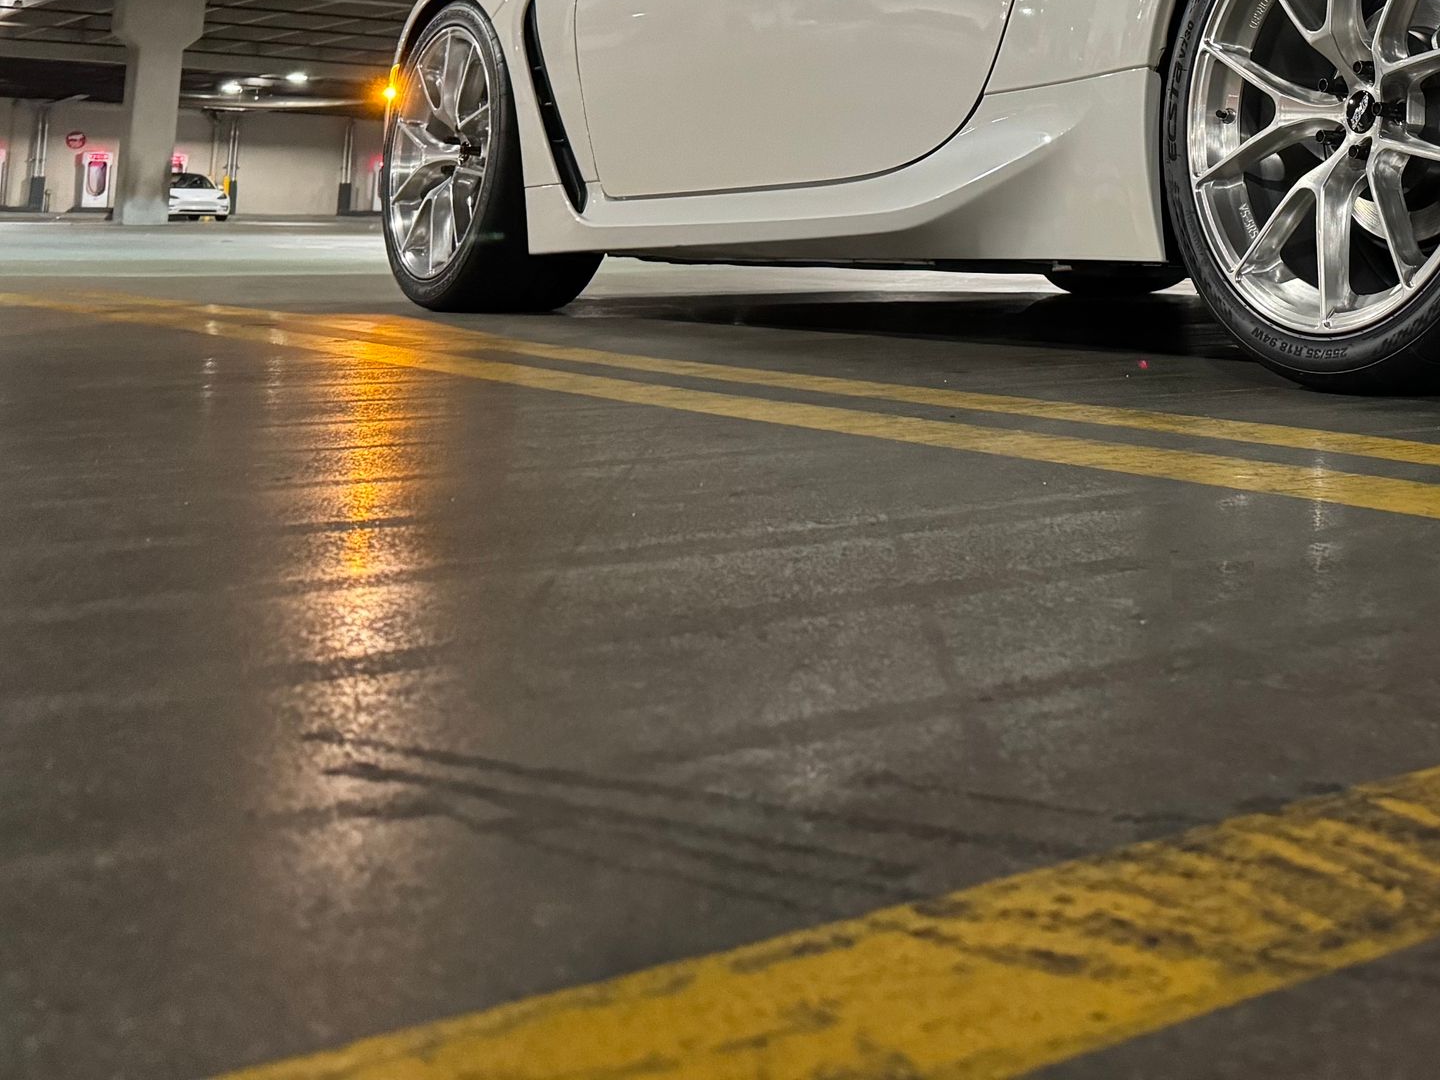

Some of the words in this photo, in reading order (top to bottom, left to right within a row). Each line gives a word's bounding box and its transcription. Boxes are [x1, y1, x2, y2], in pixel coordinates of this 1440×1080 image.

[1178, 21, 1195, 58] V730
[1250, 326, 1277, 347] 94W
[1279, 341, 1302, 358] R18
[1307, 346, 1348, 360] 255/35
